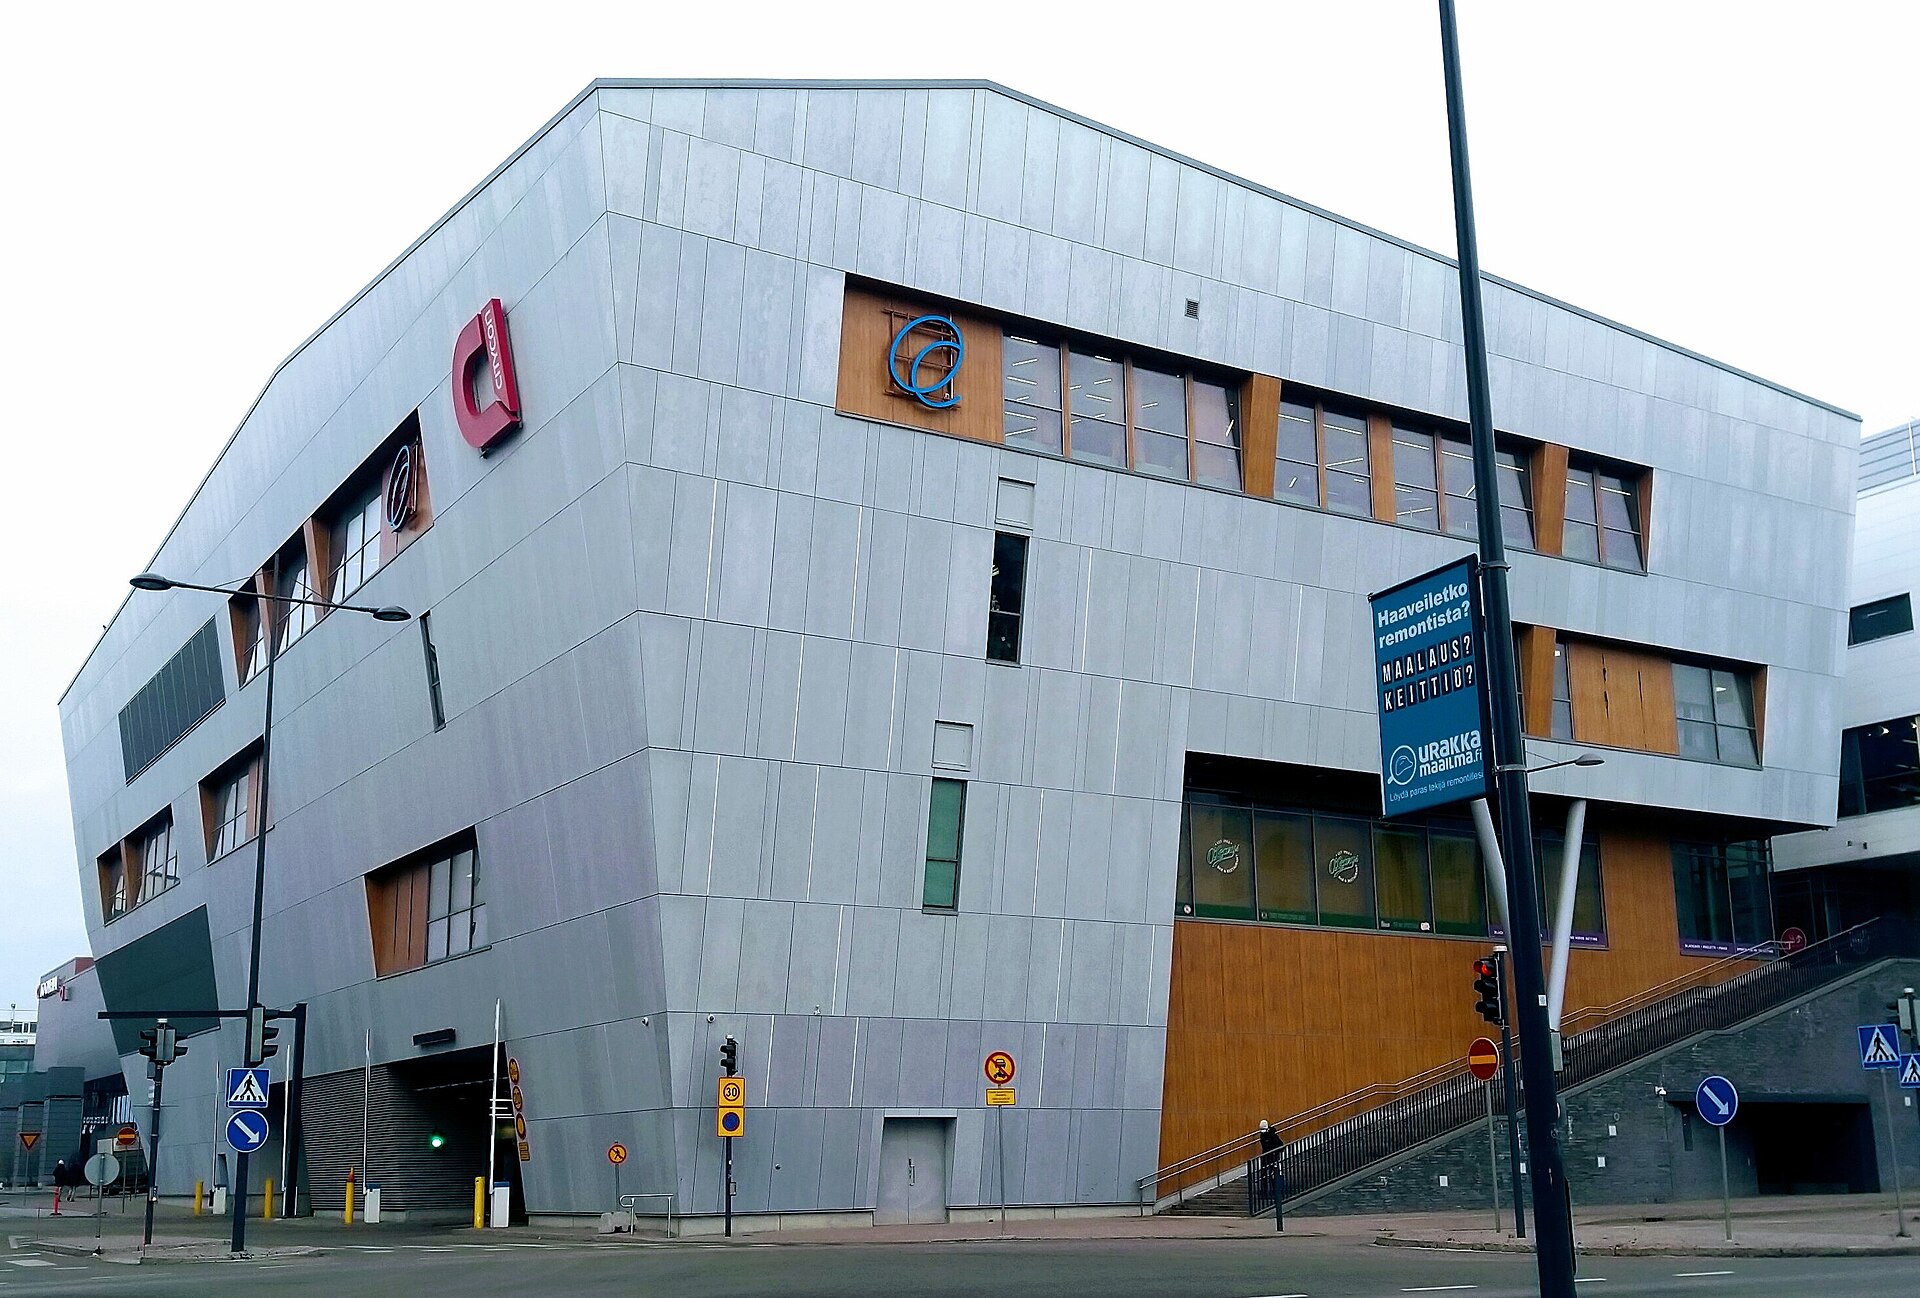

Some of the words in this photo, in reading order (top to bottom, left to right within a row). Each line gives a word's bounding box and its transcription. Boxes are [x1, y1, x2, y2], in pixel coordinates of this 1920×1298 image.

[1378, 582, 1468, 628] Haaveiletko
[1379, 600, 1471, 649] remontista?
[1382, 635, 1471, 683] MAALAUS?
[1385, 664, 1473, 711] KEITTIÖ?
[1410, 786, 1427, 798] paras
[1428, 780, 1446, 792] tekijä
[726, 1087, 737, 1097] 30
